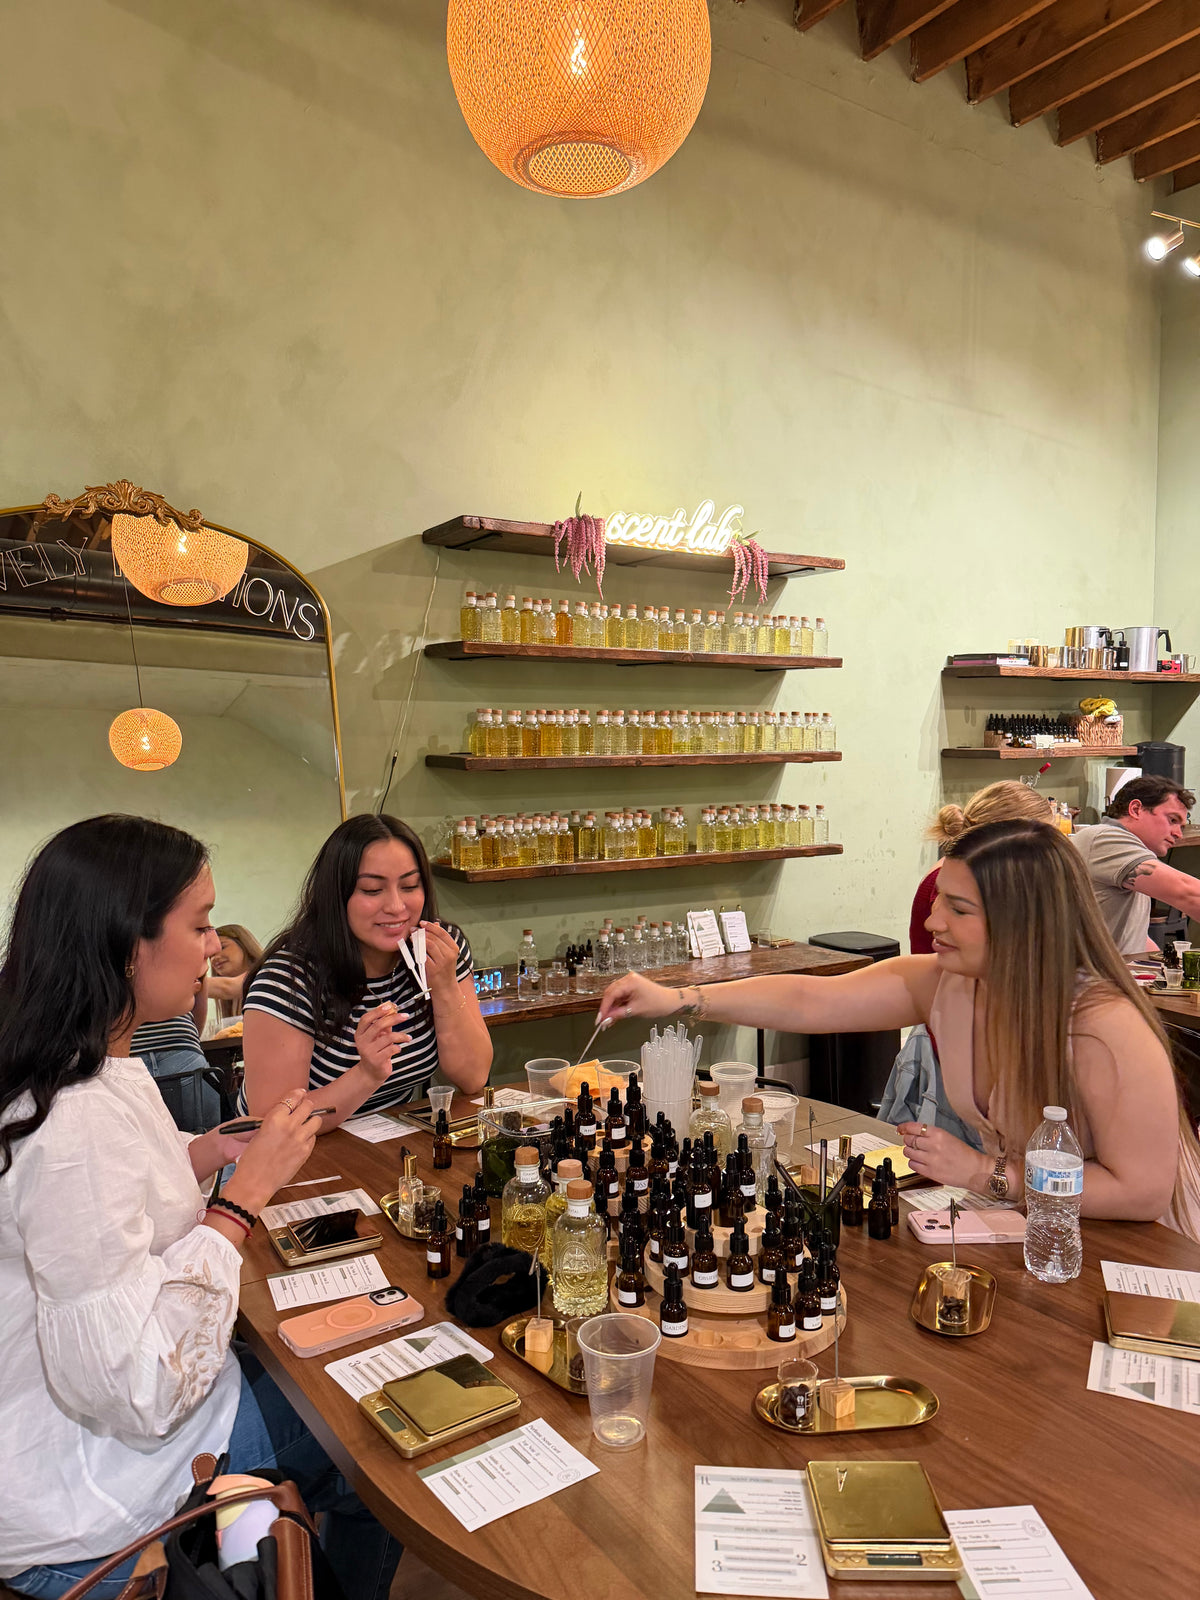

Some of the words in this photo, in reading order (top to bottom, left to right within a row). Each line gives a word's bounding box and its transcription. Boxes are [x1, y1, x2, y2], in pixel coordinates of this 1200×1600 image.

[605, 509, 686, 547] scent
[686, 500, 743, 552] lab
[0, 537, 88, 591] ELY
[714, 1539, 719, 1551] 1
[711, 1560, 723, 1572] 3
[796, 1553, 808, 1566] 2
